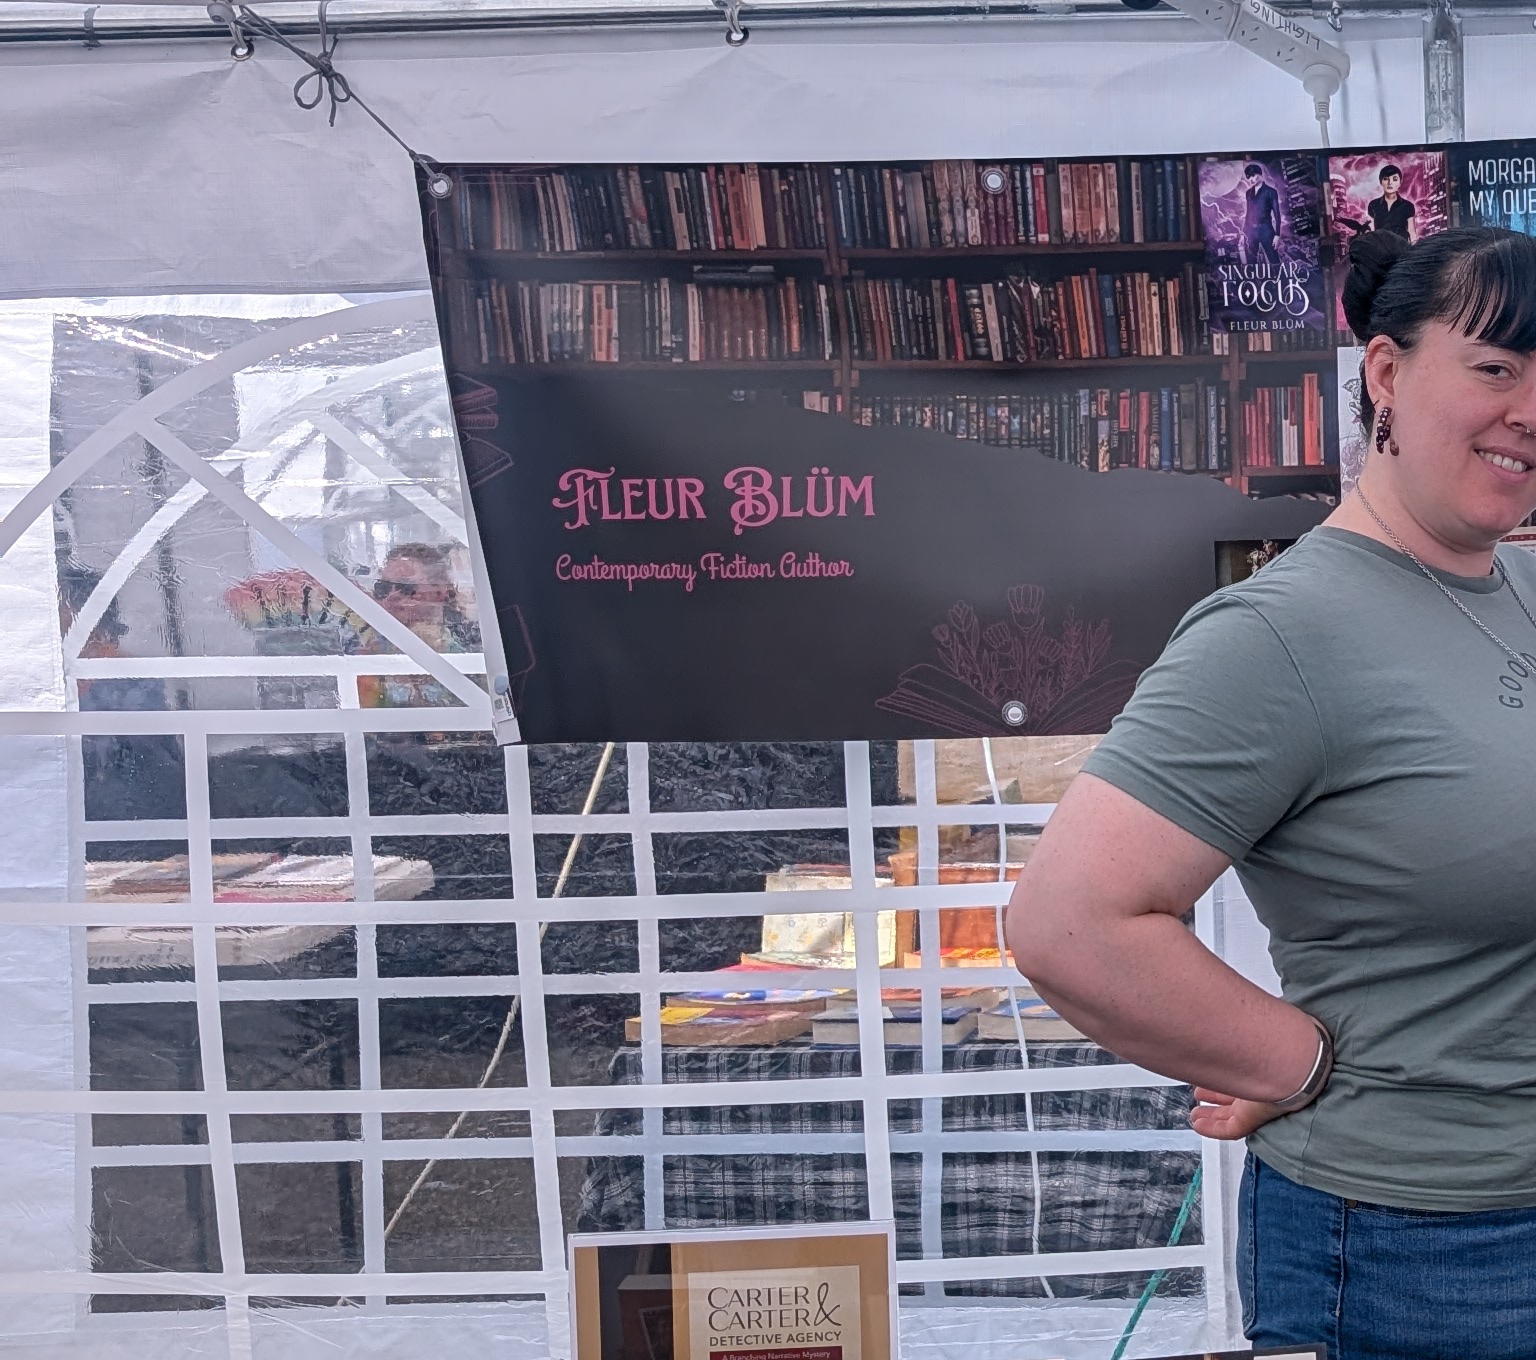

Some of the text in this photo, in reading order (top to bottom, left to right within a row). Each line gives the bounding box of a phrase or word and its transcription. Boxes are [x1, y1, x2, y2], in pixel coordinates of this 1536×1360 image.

[1470, 190, 1494, 216] MY
[1218, 262, 1309, 283] SINGULAR
[1223, 279, 1309, 315] FOCUS
[552, 466, 875, 535] FLEUR BLÜM
[556, 552, 854, 592] Contemporary Fiction Author
[708, 1282, 842, 1327] CARTER &
[708, 1308, 810, 1332] CARTER
[710, 1331, 842, 1346] DETECTIVE AGENCY
